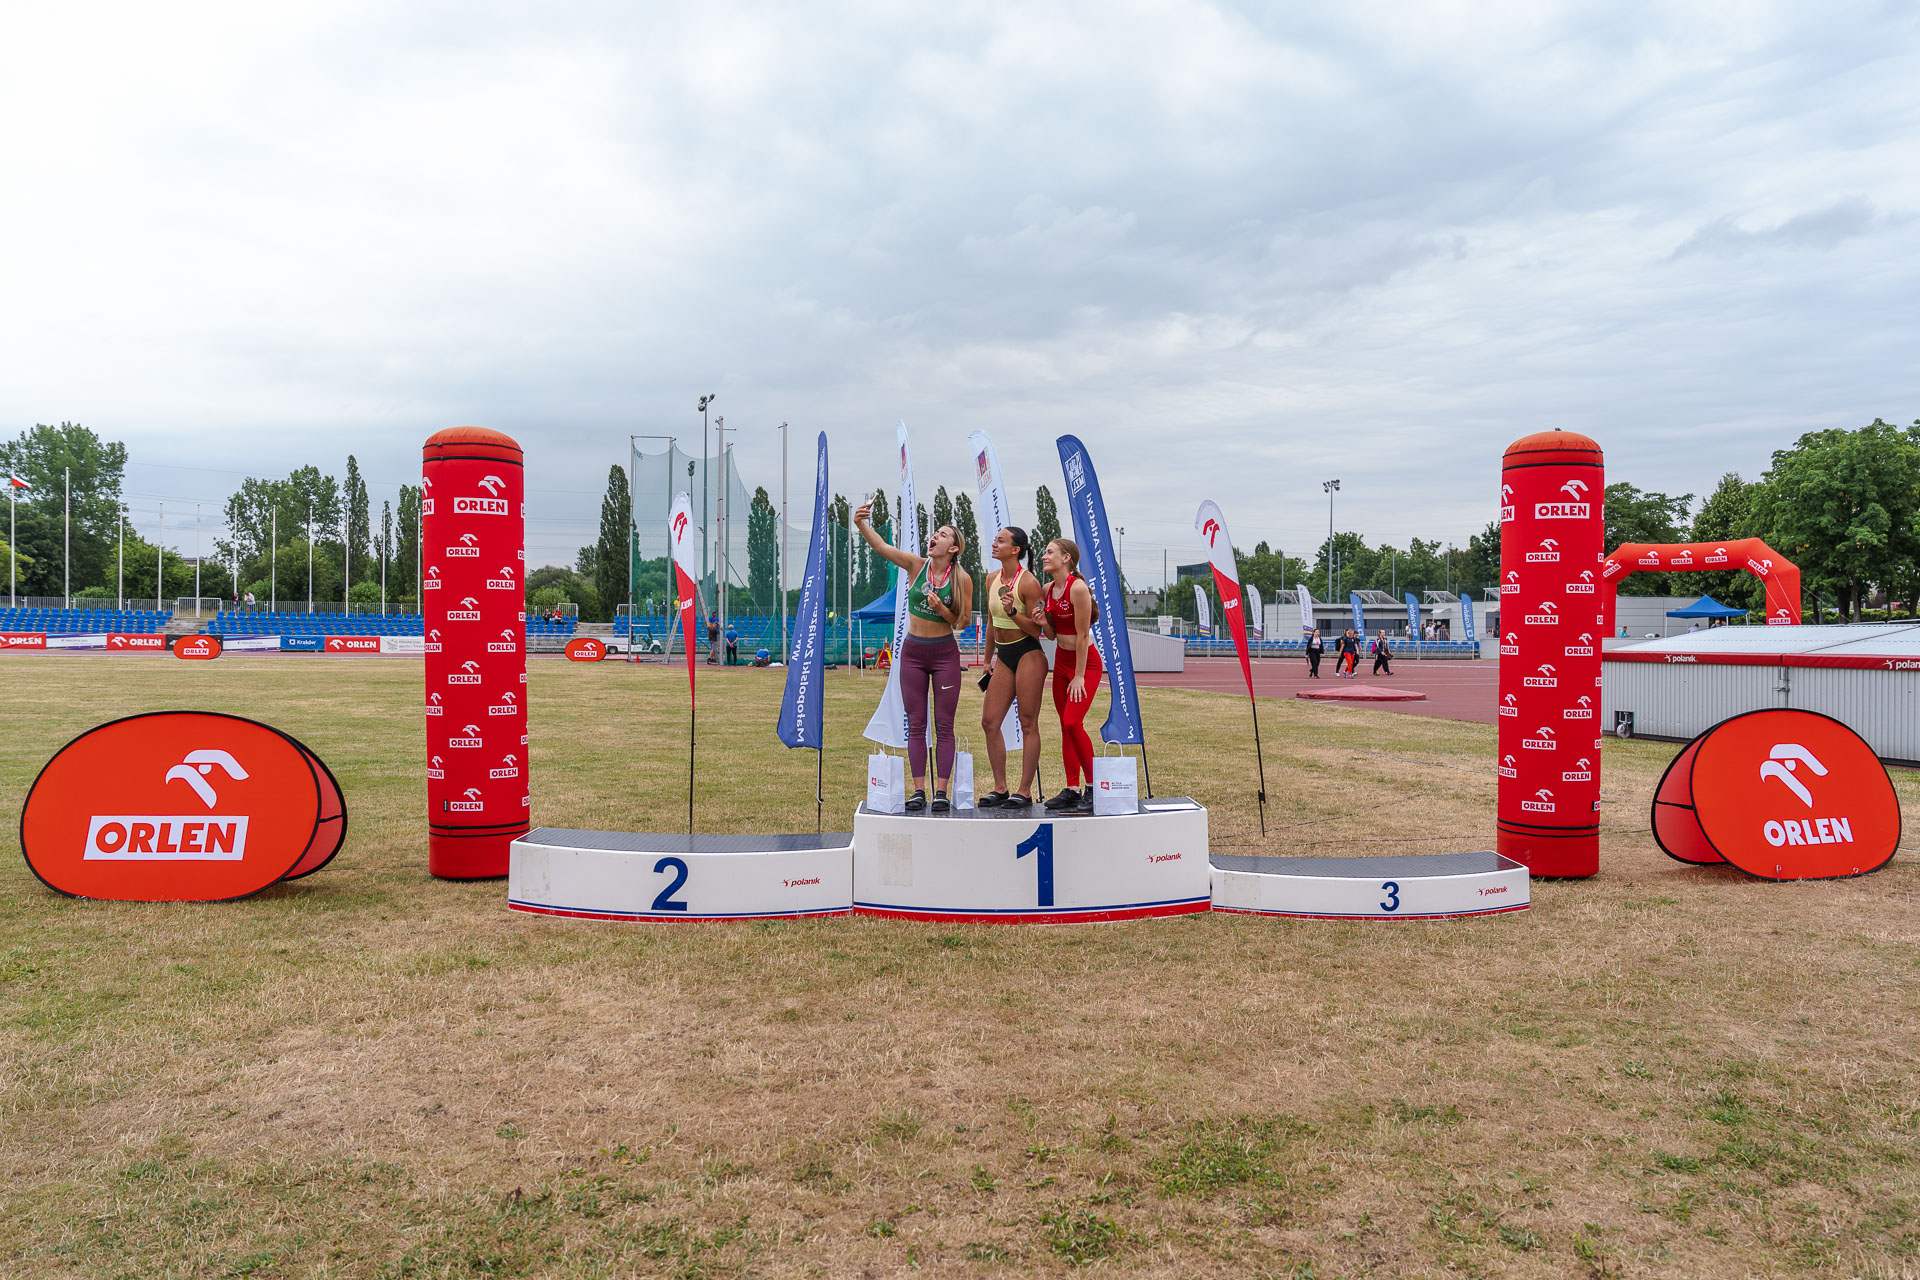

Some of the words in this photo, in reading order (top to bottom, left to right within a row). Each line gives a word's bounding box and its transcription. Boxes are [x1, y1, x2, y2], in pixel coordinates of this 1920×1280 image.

[457, 500, 504, 512] ORLEN
[1538, 506, 1586, 516] ORLEN
[1749, 560, 1767, 574] ORLEN
[1896, 660, 1920, 670] polan
[492, 769, 516, 777] ORLEN
[1524, 802, 1552, 810] ORLEN
[1764, 817, 1854, 846] ORLEN
[96, 822, 237, 853] ORLEN
[1156, 852, 1182, 863] polanik
[1016, 823, 1054, 906] 1
[651, 857, 688, 912] 2
[790, 877, 820, 888] polanik
[1380, 882, 1399, 911] 3
[1485, 886, 1508, 896] polanik
